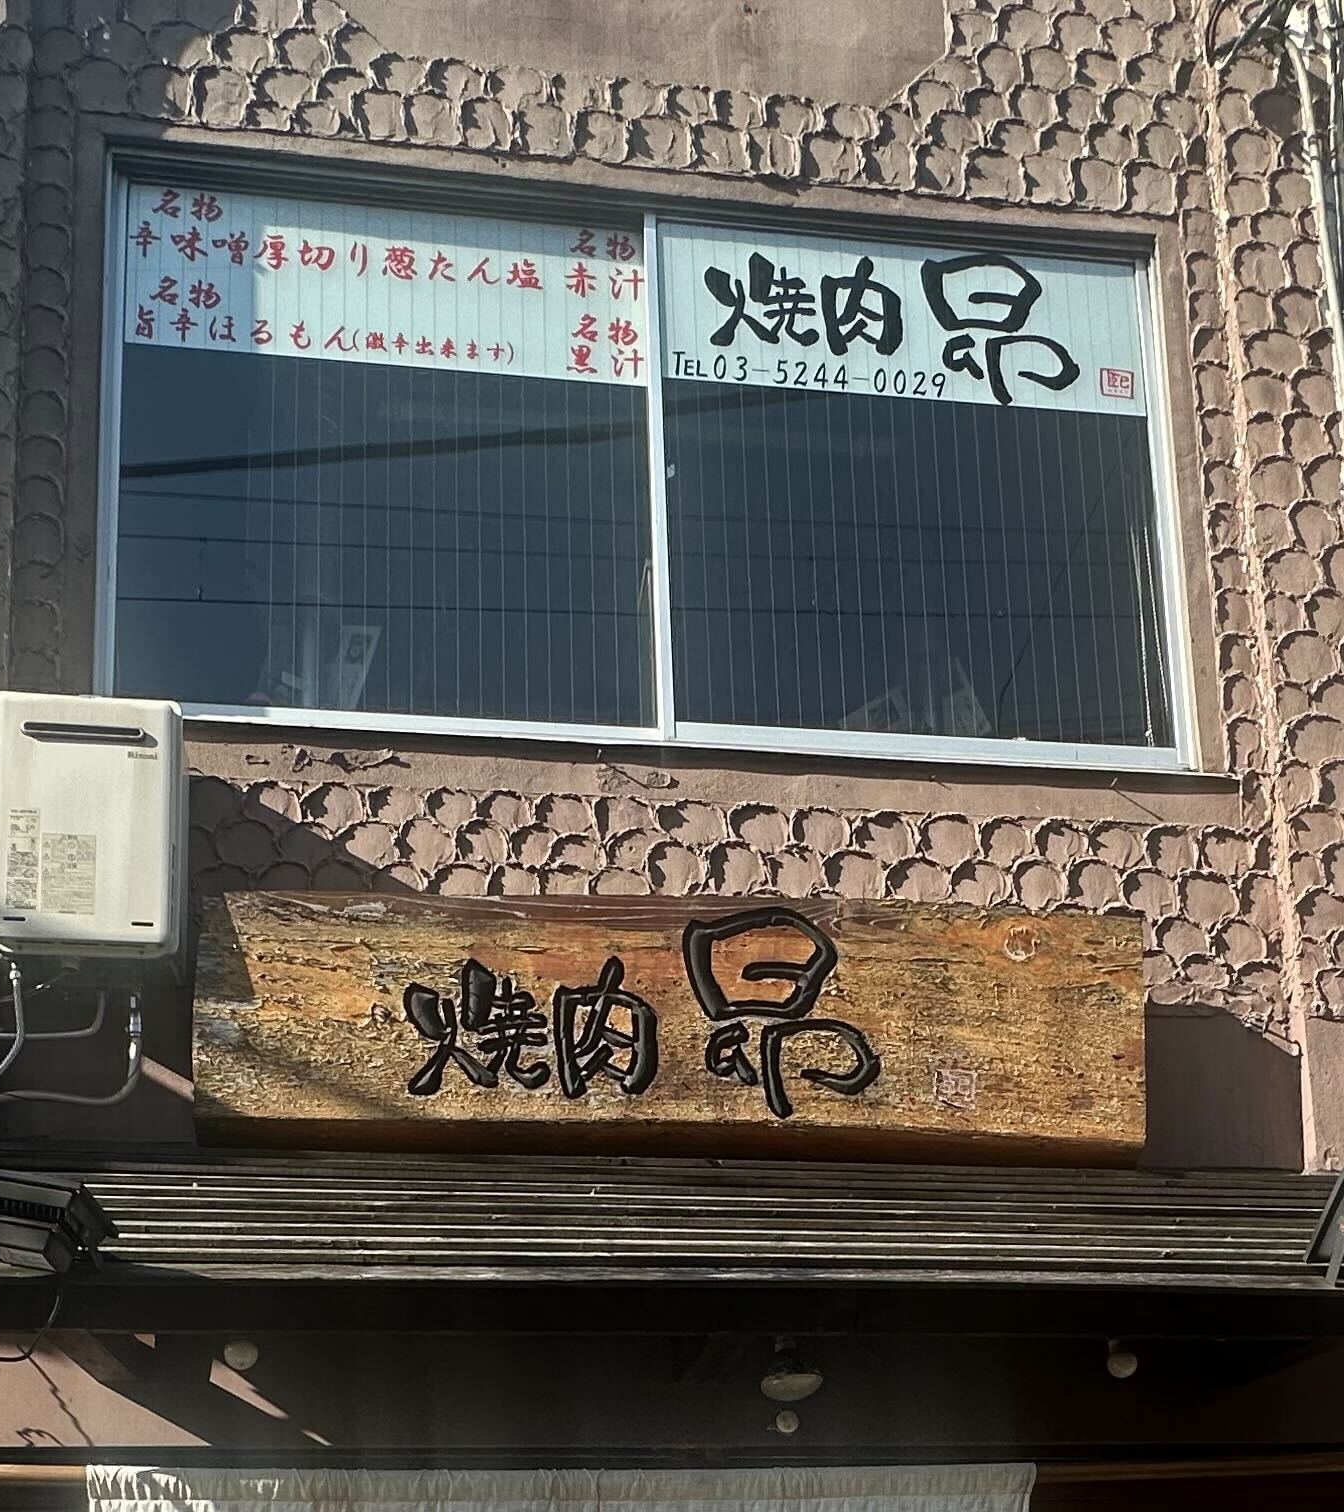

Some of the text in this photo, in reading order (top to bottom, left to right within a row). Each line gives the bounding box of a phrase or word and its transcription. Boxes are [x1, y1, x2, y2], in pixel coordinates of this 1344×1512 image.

[152, 188, 222, 222] 名物
[570, 229, 637, 263] 名物
[150, 276, 222, 309] 名物
[564, 261, 644, 302] 赤汁
[571, 314, 638, 345] 名物
[565, 346, 644, 379] 黒汁
[672, 351, 948, 399] TEL 03-5244-0029
